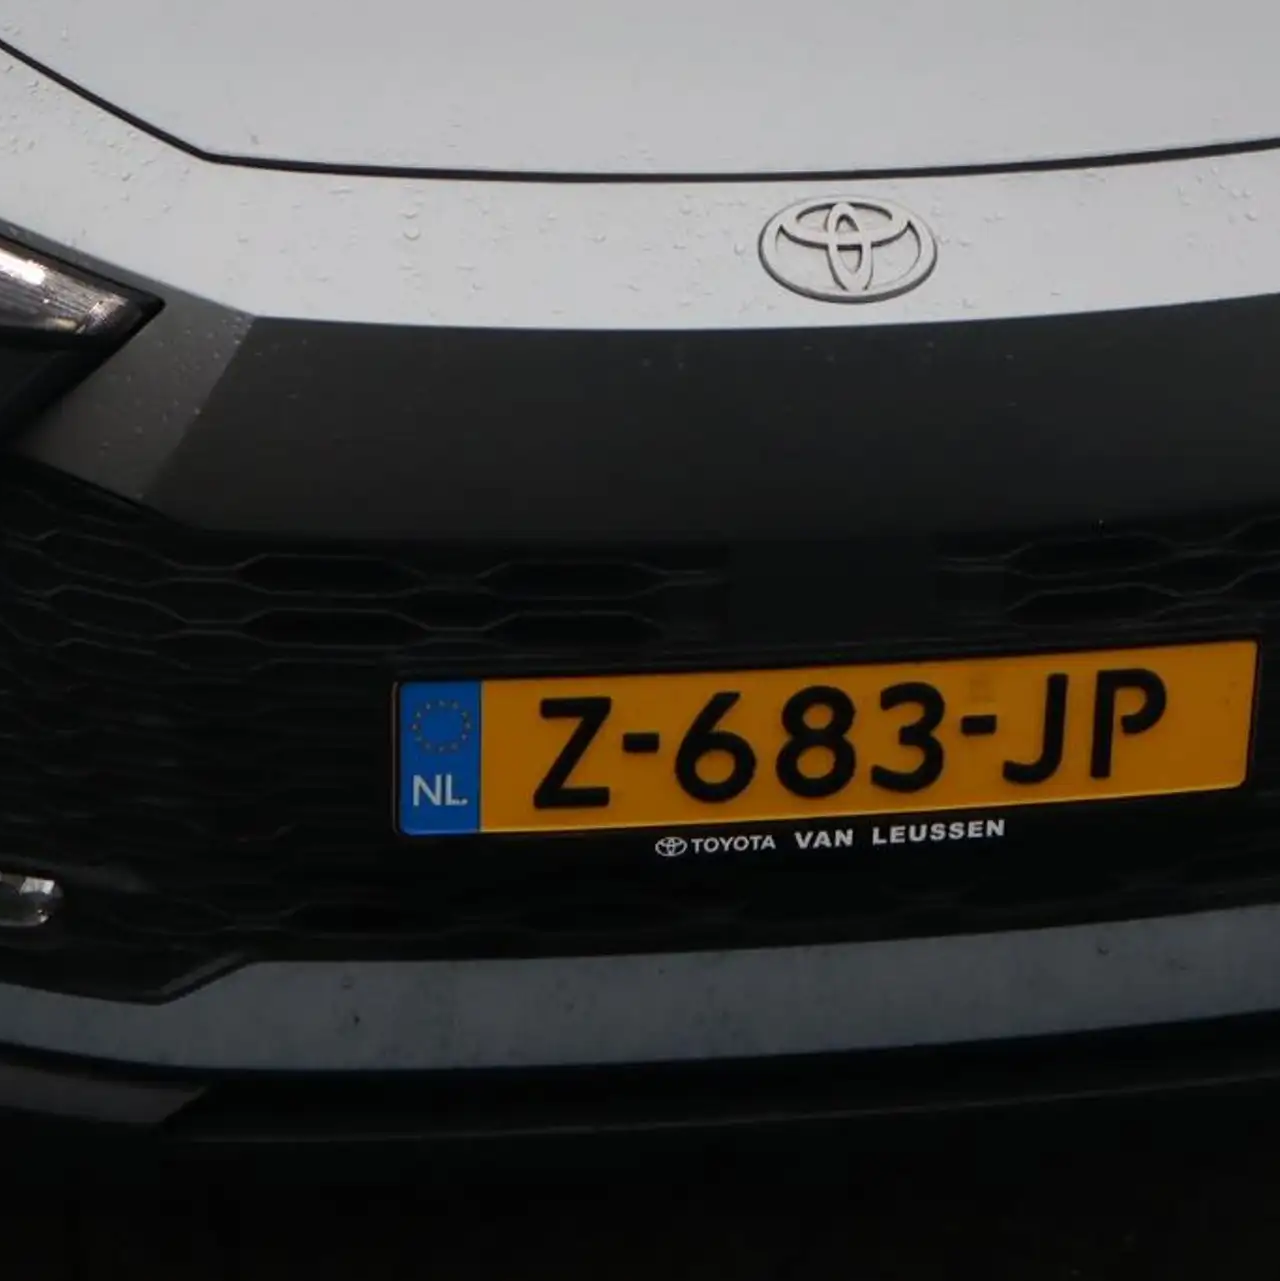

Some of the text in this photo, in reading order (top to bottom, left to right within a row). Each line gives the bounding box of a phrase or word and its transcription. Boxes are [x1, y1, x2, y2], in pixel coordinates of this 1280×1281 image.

[534, 669, 1167, 809] Z-683-JP
[412, 773, 468, 807] NL
[691, 818, 1007, 854] TOYOTA VAN LEUSSEN
